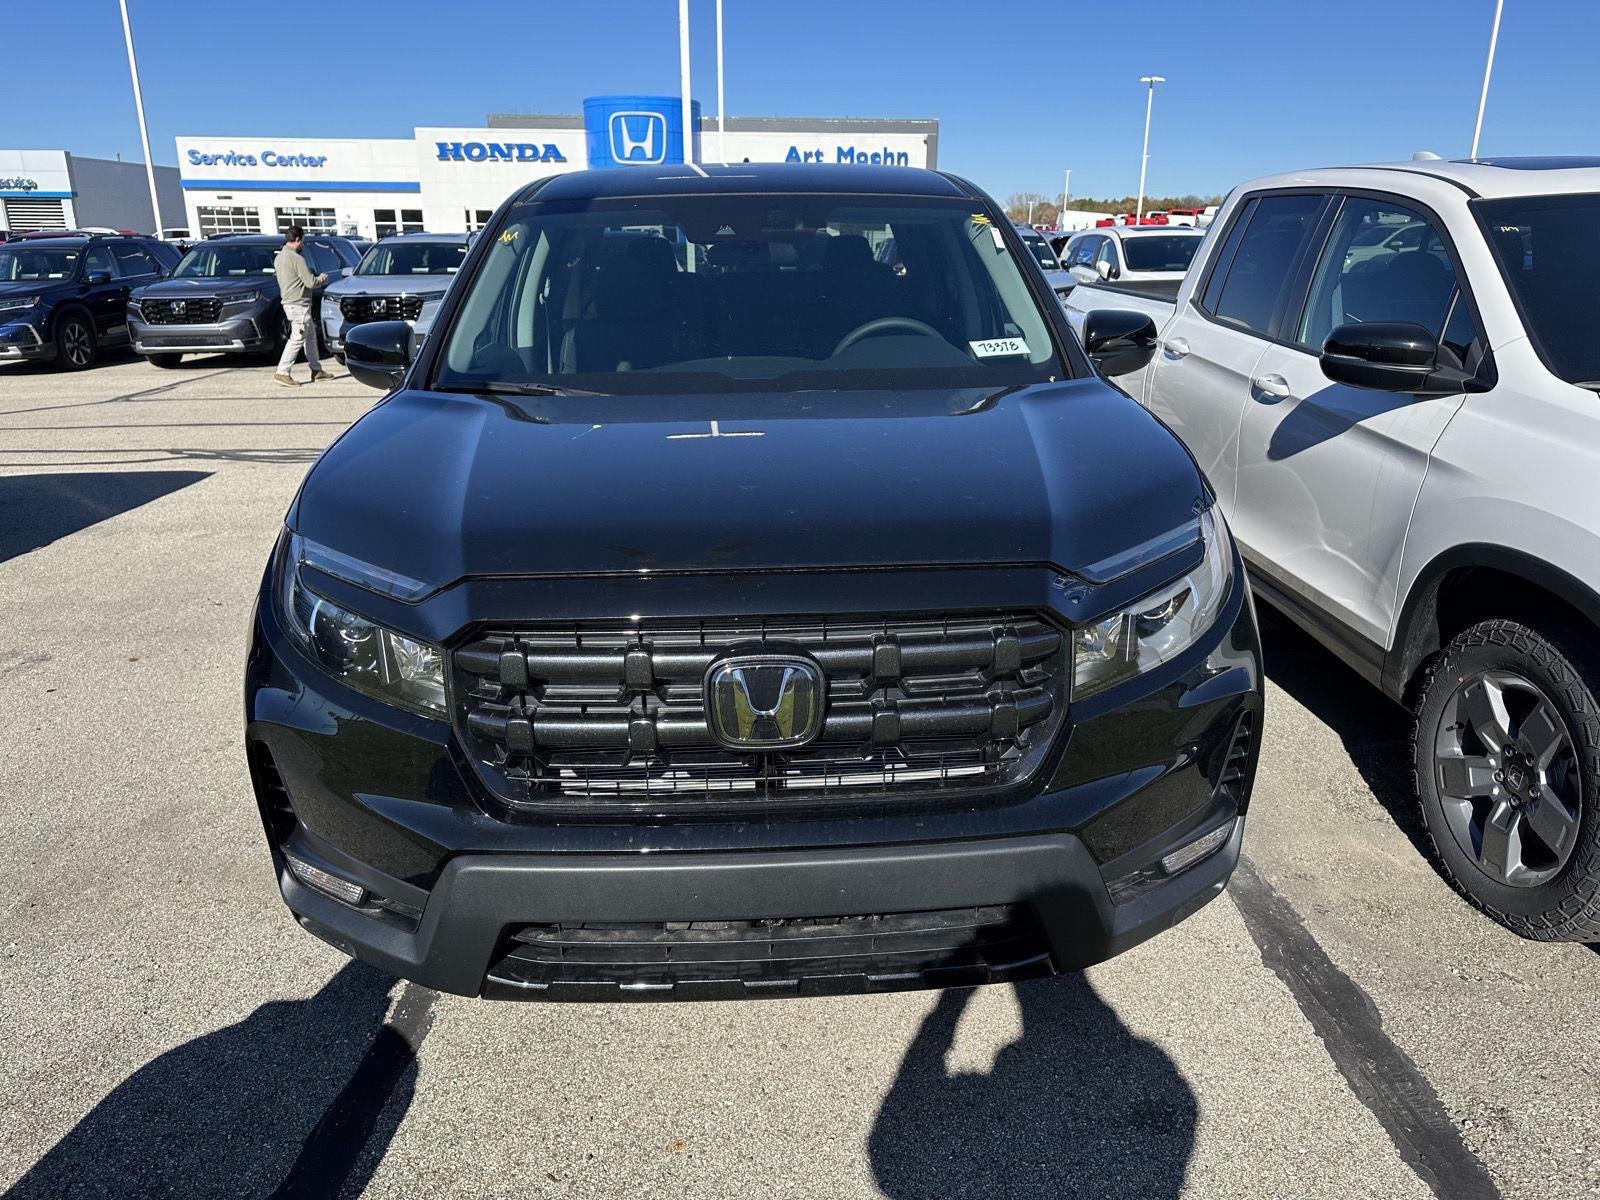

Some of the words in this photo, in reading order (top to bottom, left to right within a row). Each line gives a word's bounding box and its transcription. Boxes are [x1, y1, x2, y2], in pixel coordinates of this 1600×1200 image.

[187, 149, 258, 166] Service
[260, 150, 328, 168] Center
[435, 141, 567, 162] HONDA
[784, 145, 824, 163] Art
[836, 145, 909, 166] Moehn
[977, 340, 1019, 352] 73378
